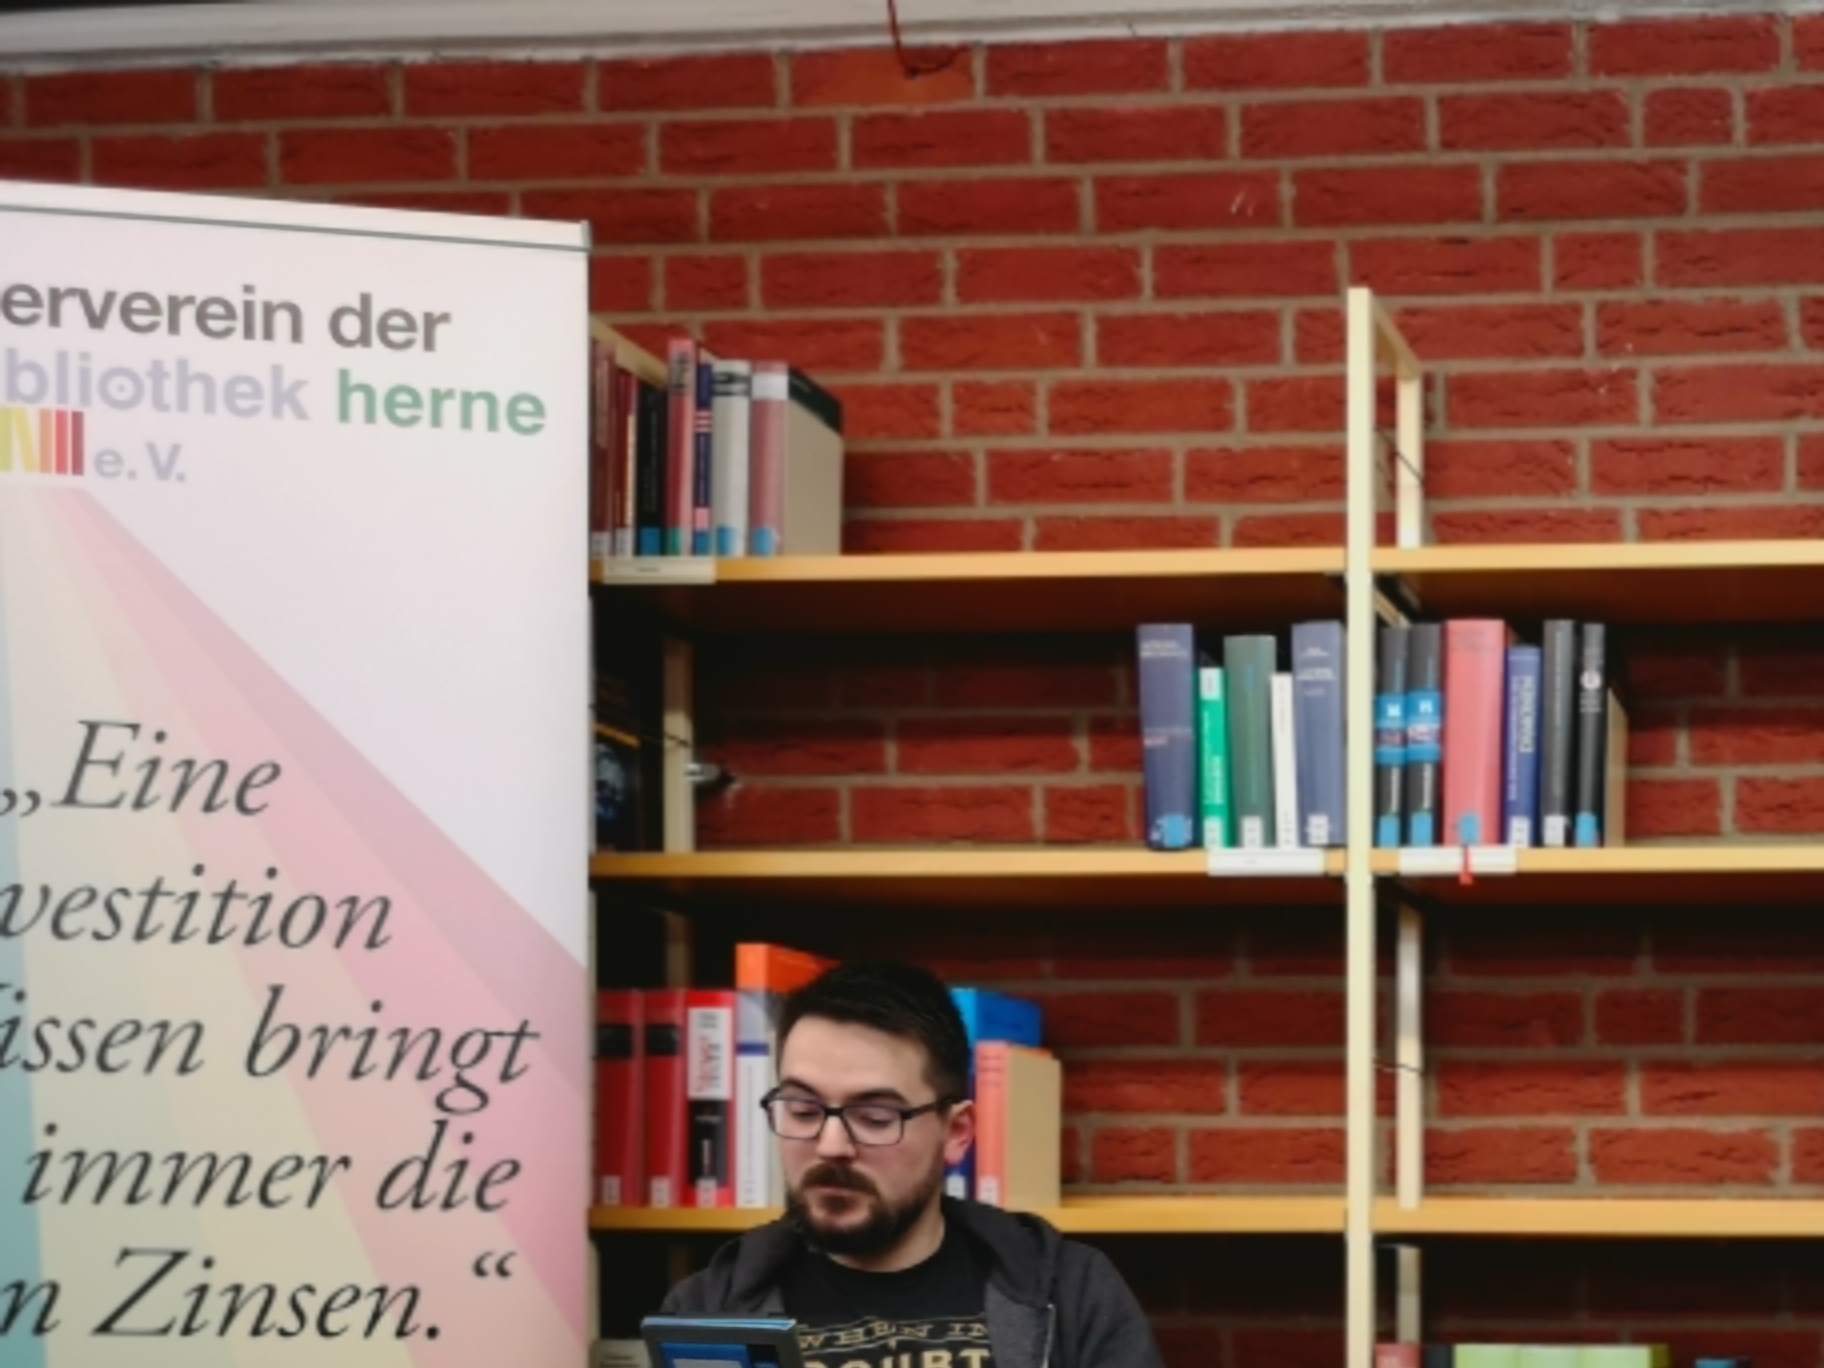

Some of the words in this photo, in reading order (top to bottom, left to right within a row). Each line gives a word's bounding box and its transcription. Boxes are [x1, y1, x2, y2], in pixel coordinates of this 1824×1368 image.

[328, 293, 452, 352] der
[337, 368, 546, 435] herne
[0, 719, 283, 818] „Eine
[0, 863, 393, 949] vestition
[0, 983, 204, 1075] issen
[245, 984, 541, 1115] bringt
[22, 1123, 351, 1210] immer
[376, 1120, 522, 1213] die
